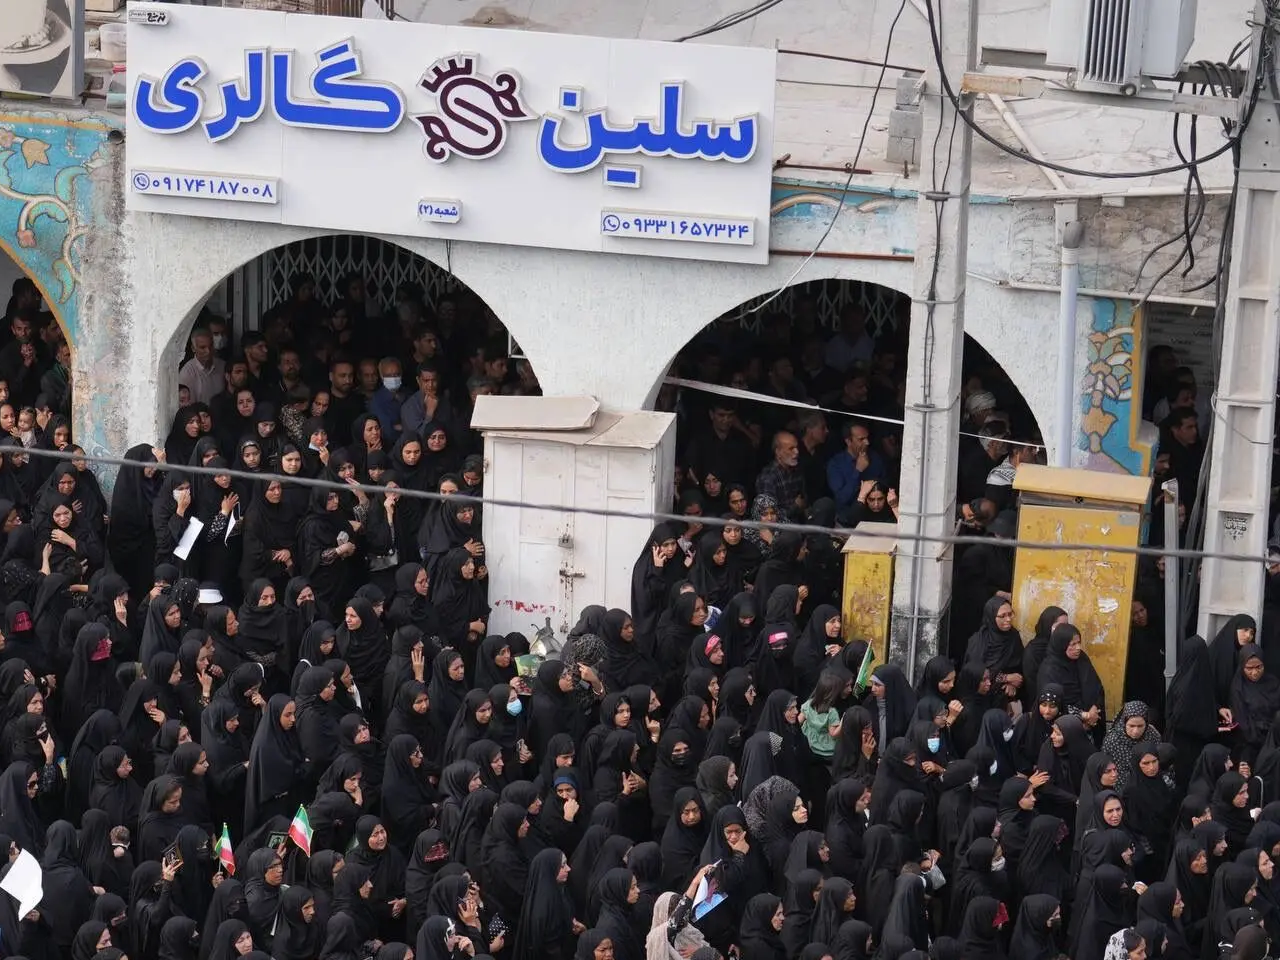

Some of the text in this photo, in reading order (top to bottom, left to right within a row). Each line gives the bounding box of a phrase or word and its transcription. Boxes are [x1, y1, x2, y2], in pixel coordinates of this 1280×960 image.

[133, 38, 759, 188] سلین گالری
[153, 177, 273, 198] ۰۹۱۷۴۱۸۷۰۰۸
[434, 206, 458, 218] شعبه
[622, 217, 750, 239] ۰۹۳۳۱۶۵۷۳۲۴
